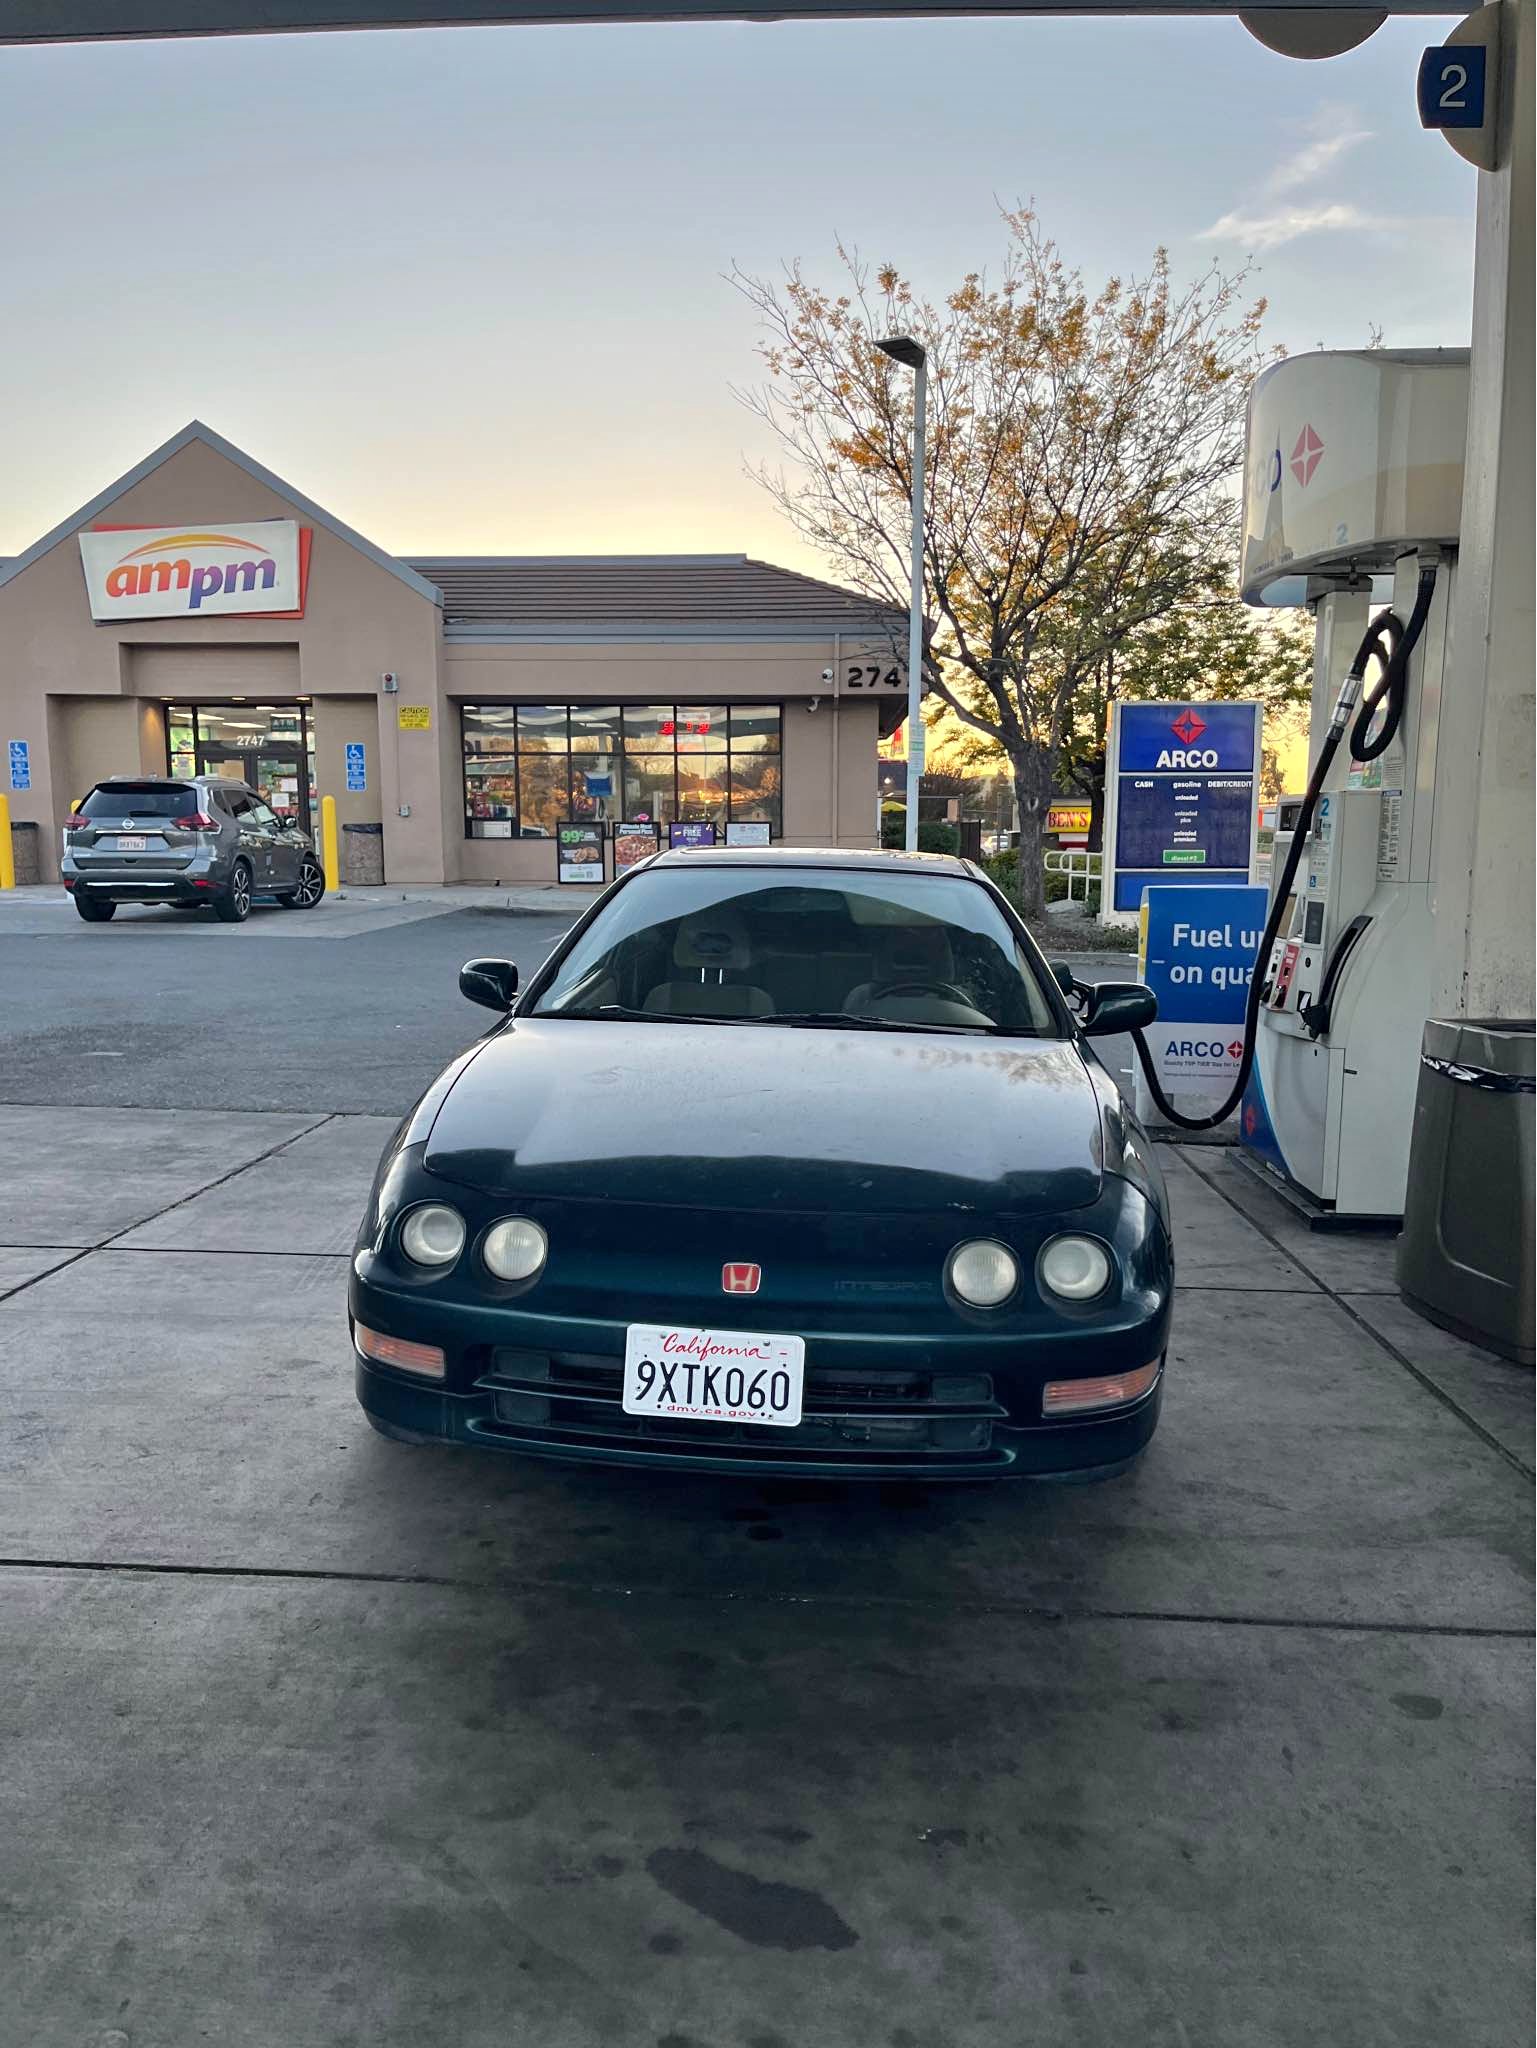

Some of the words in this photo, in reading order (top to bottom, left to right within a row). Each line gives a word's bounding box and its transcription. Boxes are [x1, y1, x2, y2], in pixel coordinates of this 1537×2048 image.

[1440, 65, 1467, 107] 2
[1336, 523, 1348, 545] 2
[106, 558, 276, 609] ampm
[848, 666, 909, 688] 274
[273, 719, 295, 727] ATM
[236, 735, 265, 746] 2747
[1156, 749, 1219, 769] ARCO
[1173, 781, 1202, 789] gasoline
[1321, 798, 1330, 816] 2
[683, 829, 702, 837] FREE
[1173, 923, 1233, 948] Fuel
[1170, 965, 1203, 984] on
[1165, 1041, 1225, 1058] ARCO
[663, 1333, 770, 1361] California
[636, 1360, 790, 1411] 9XTK060
[667, 1404, 756, 1418] dmv.ca.gov
